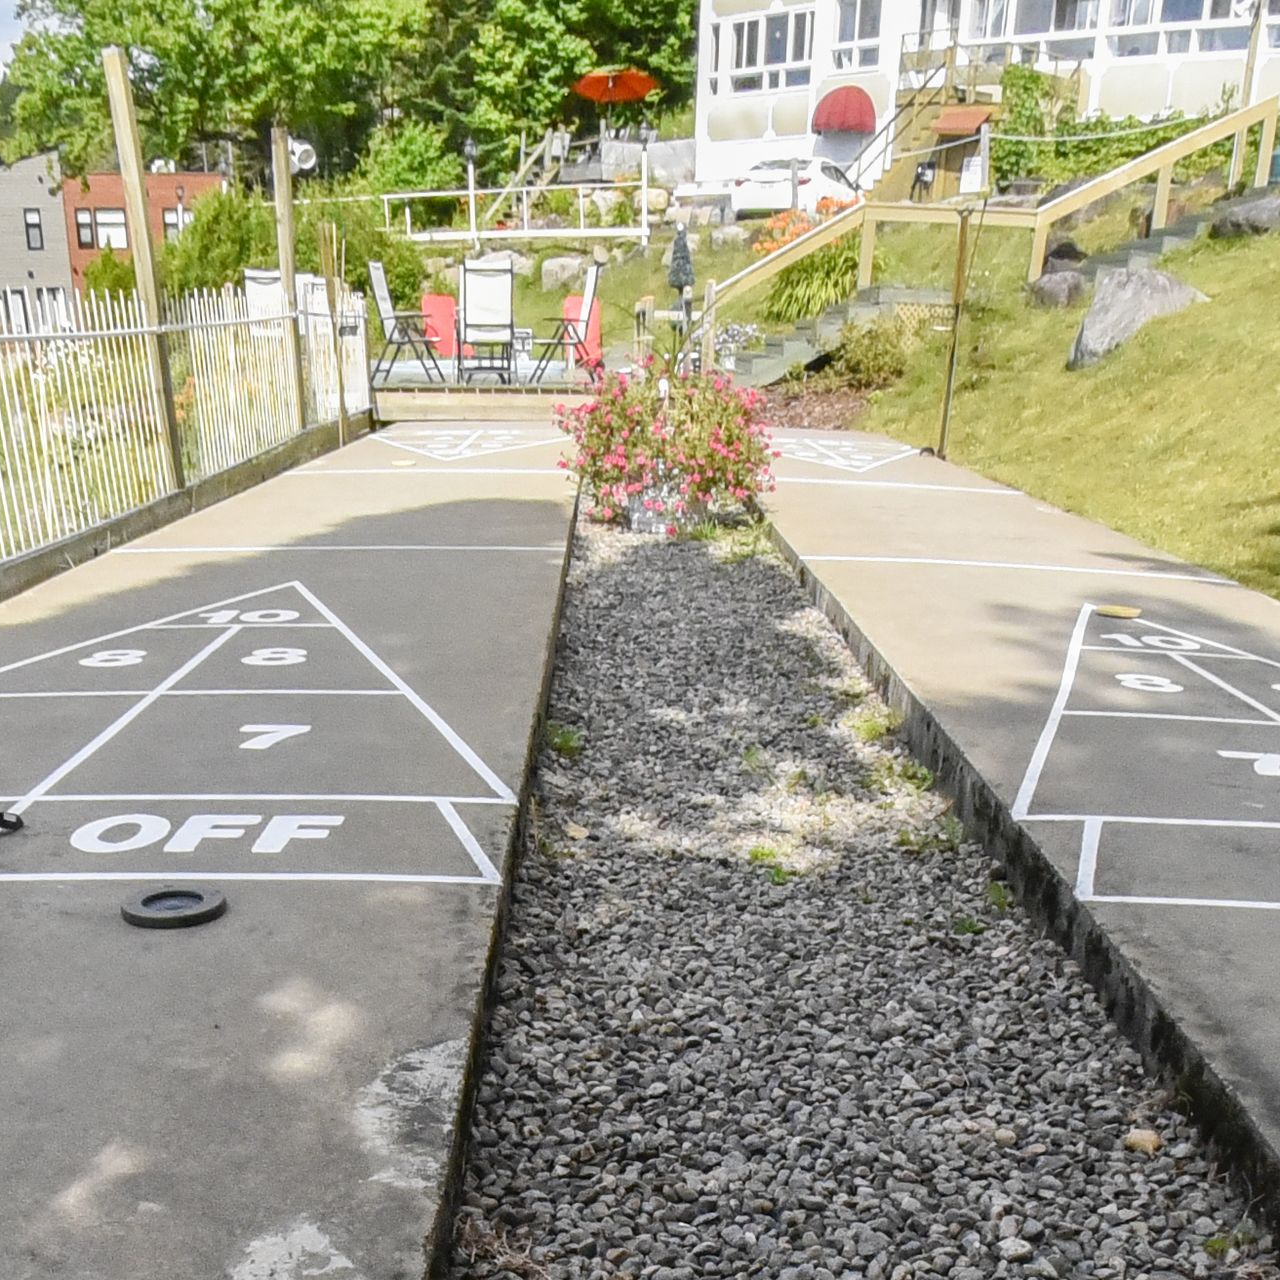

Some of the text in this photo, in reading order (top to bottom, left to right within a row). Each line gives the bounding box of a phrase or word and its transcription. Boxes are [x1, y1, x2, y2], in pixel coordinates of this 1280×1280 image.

[198, 609, 300, 624] 10
[1099, 632, 1201, 650] 10
[78, 647, 308, 668] 8 8
[1114, 673, 1185, 693] 8
[238, 724, 313, 751] 7
[68, 812, 346, 855] OFF
